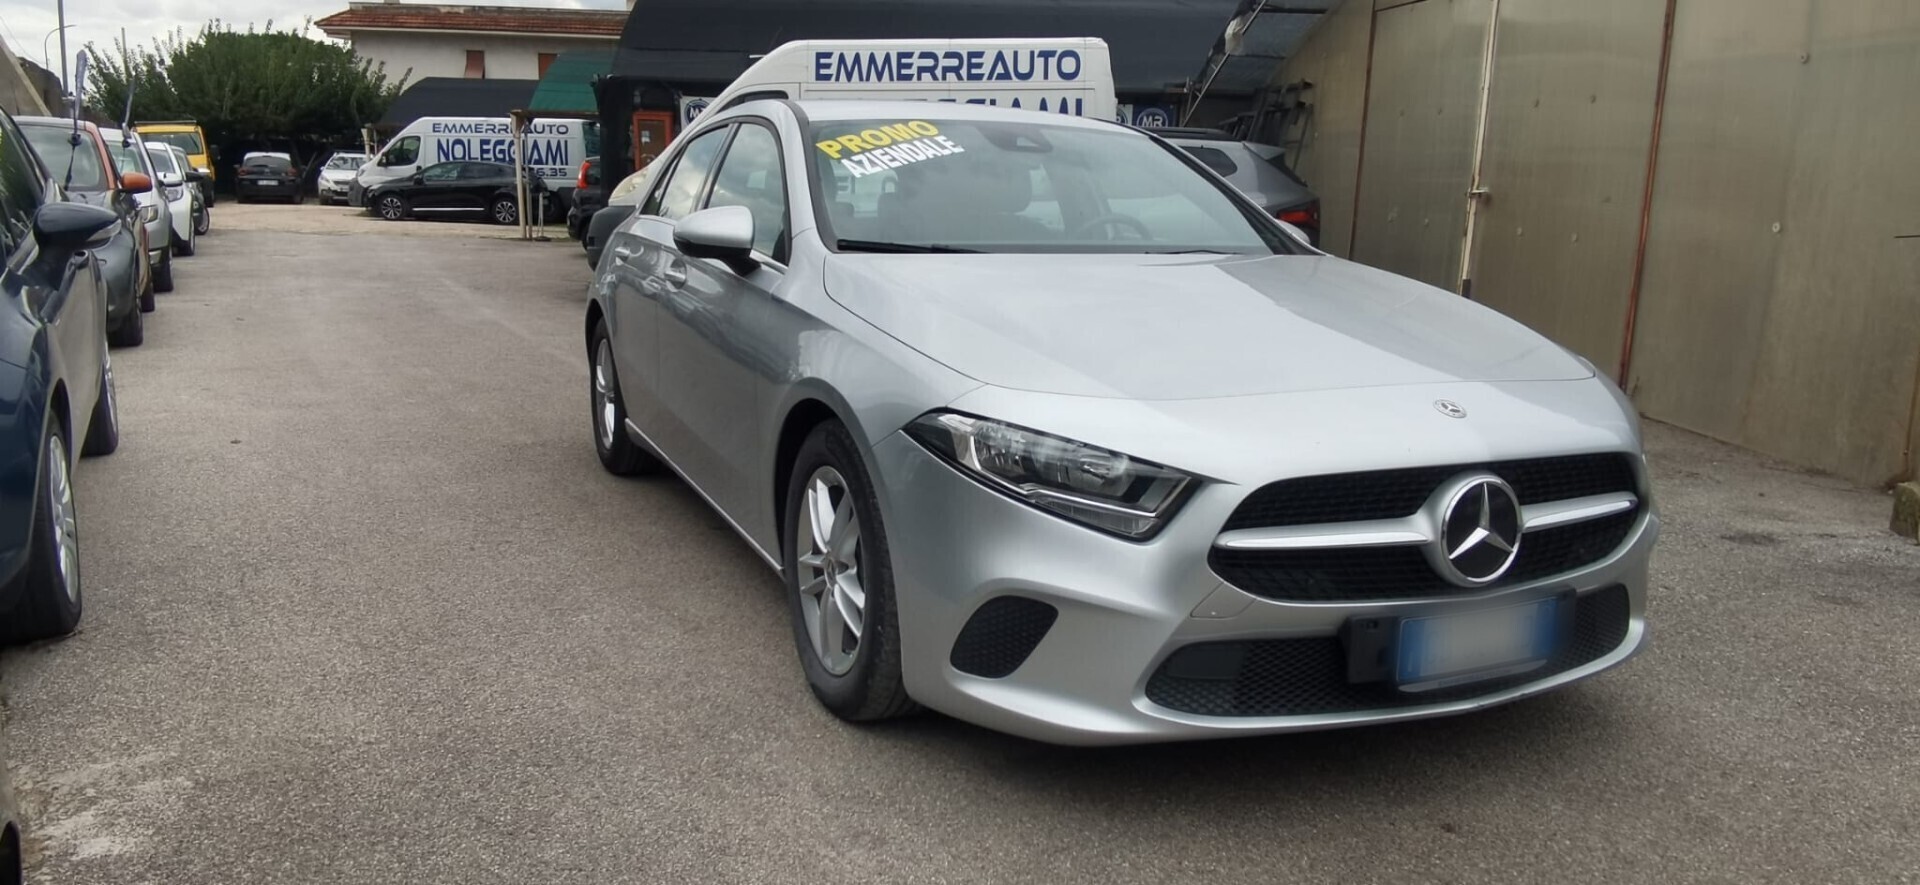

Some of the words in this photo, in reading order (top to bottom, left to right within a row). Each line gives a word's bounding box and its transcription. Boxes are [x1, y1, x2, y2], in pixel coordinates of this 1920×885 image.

[815, 49, 1082, 83] EMMERREAUTO
[432, 123, 569, 135] EMMERRAUTO
[815, 119, 940, 160] PROMO
[840, 135, 966, 178] AZIENDALE
